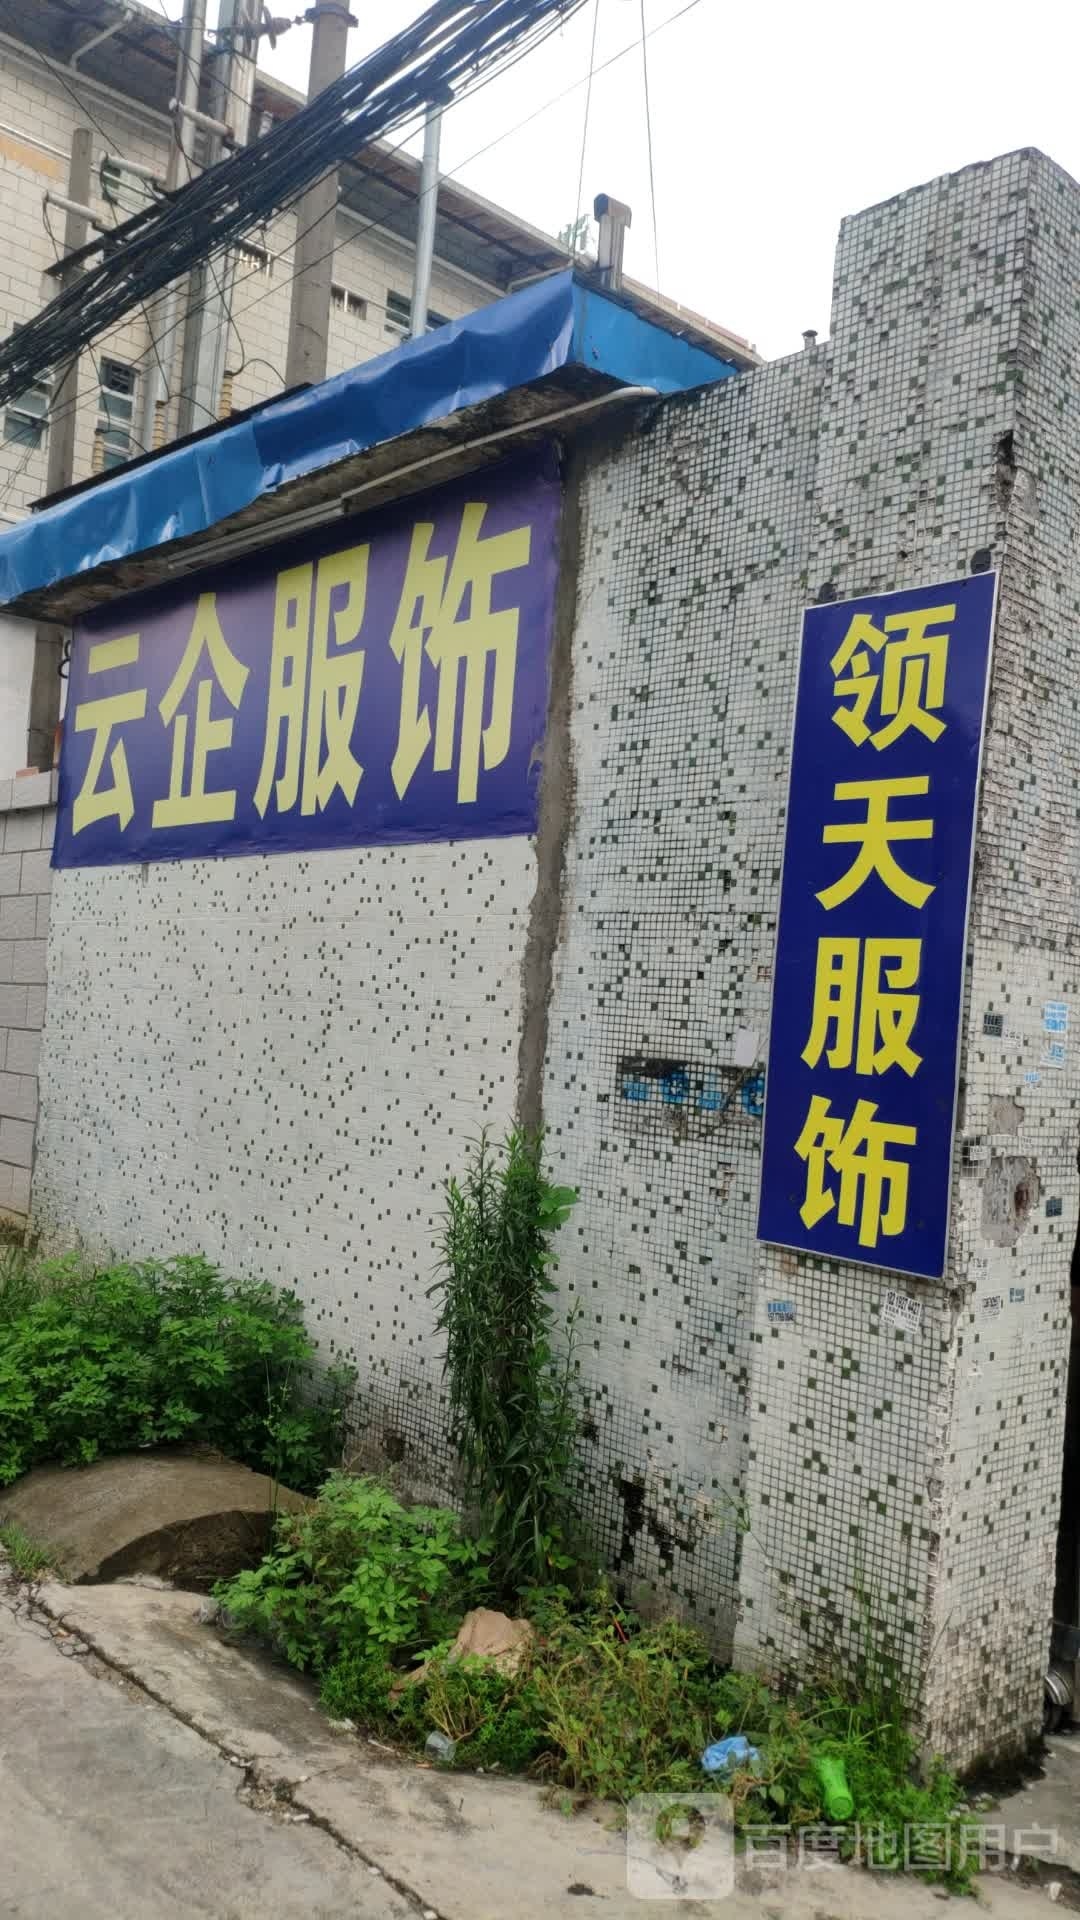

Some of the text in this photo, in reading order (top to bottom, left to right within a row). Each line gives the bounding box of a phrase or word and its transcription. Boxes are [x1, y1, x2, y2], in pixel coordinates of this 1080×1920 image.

[72, 502, 532, 836] 云企服饰
[793, 603, 957, 1248] 领天服饰
